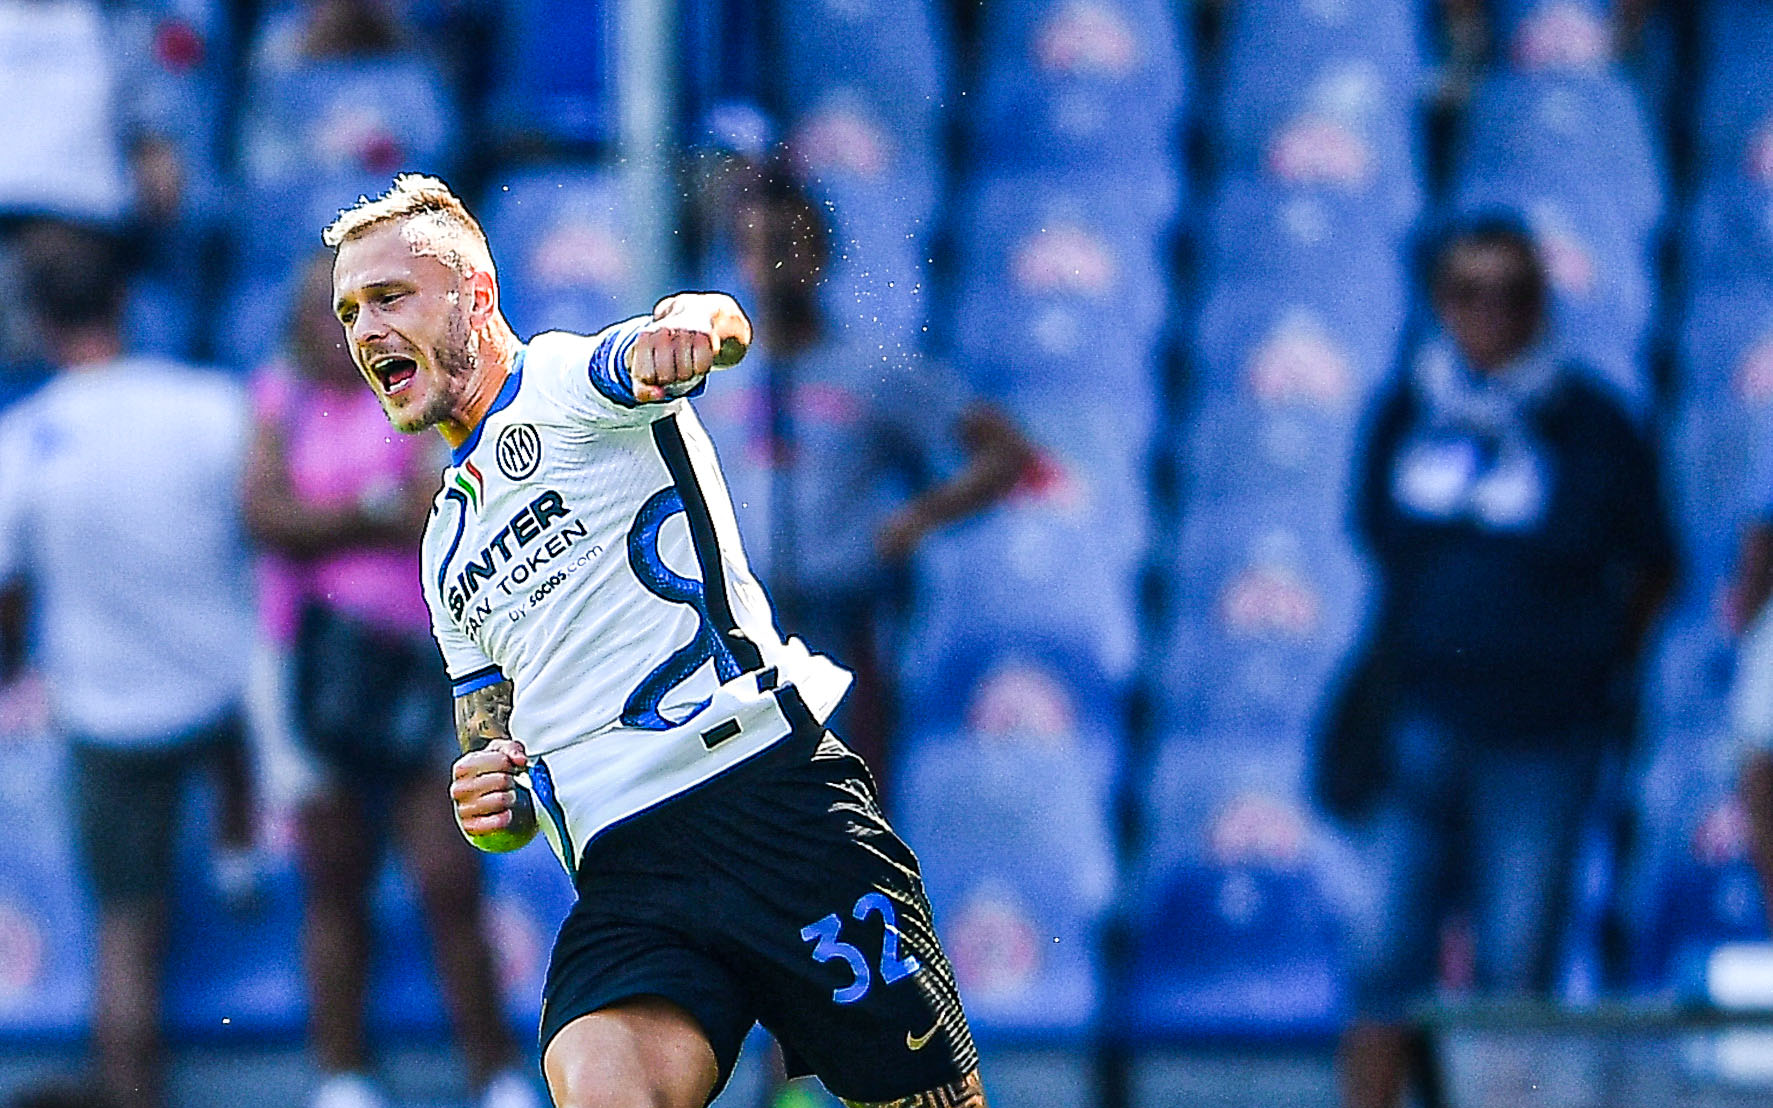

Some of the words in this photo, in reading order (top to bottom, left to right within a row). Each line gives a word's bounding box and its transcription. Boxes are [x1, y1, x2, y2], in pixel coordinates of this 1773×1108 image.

[496, 519, 588, 595] TOKEN
[509, 604, 526, 622] by
[529, 545, 604, 607] socios.com
[800, 892, 922, 1003] 32
